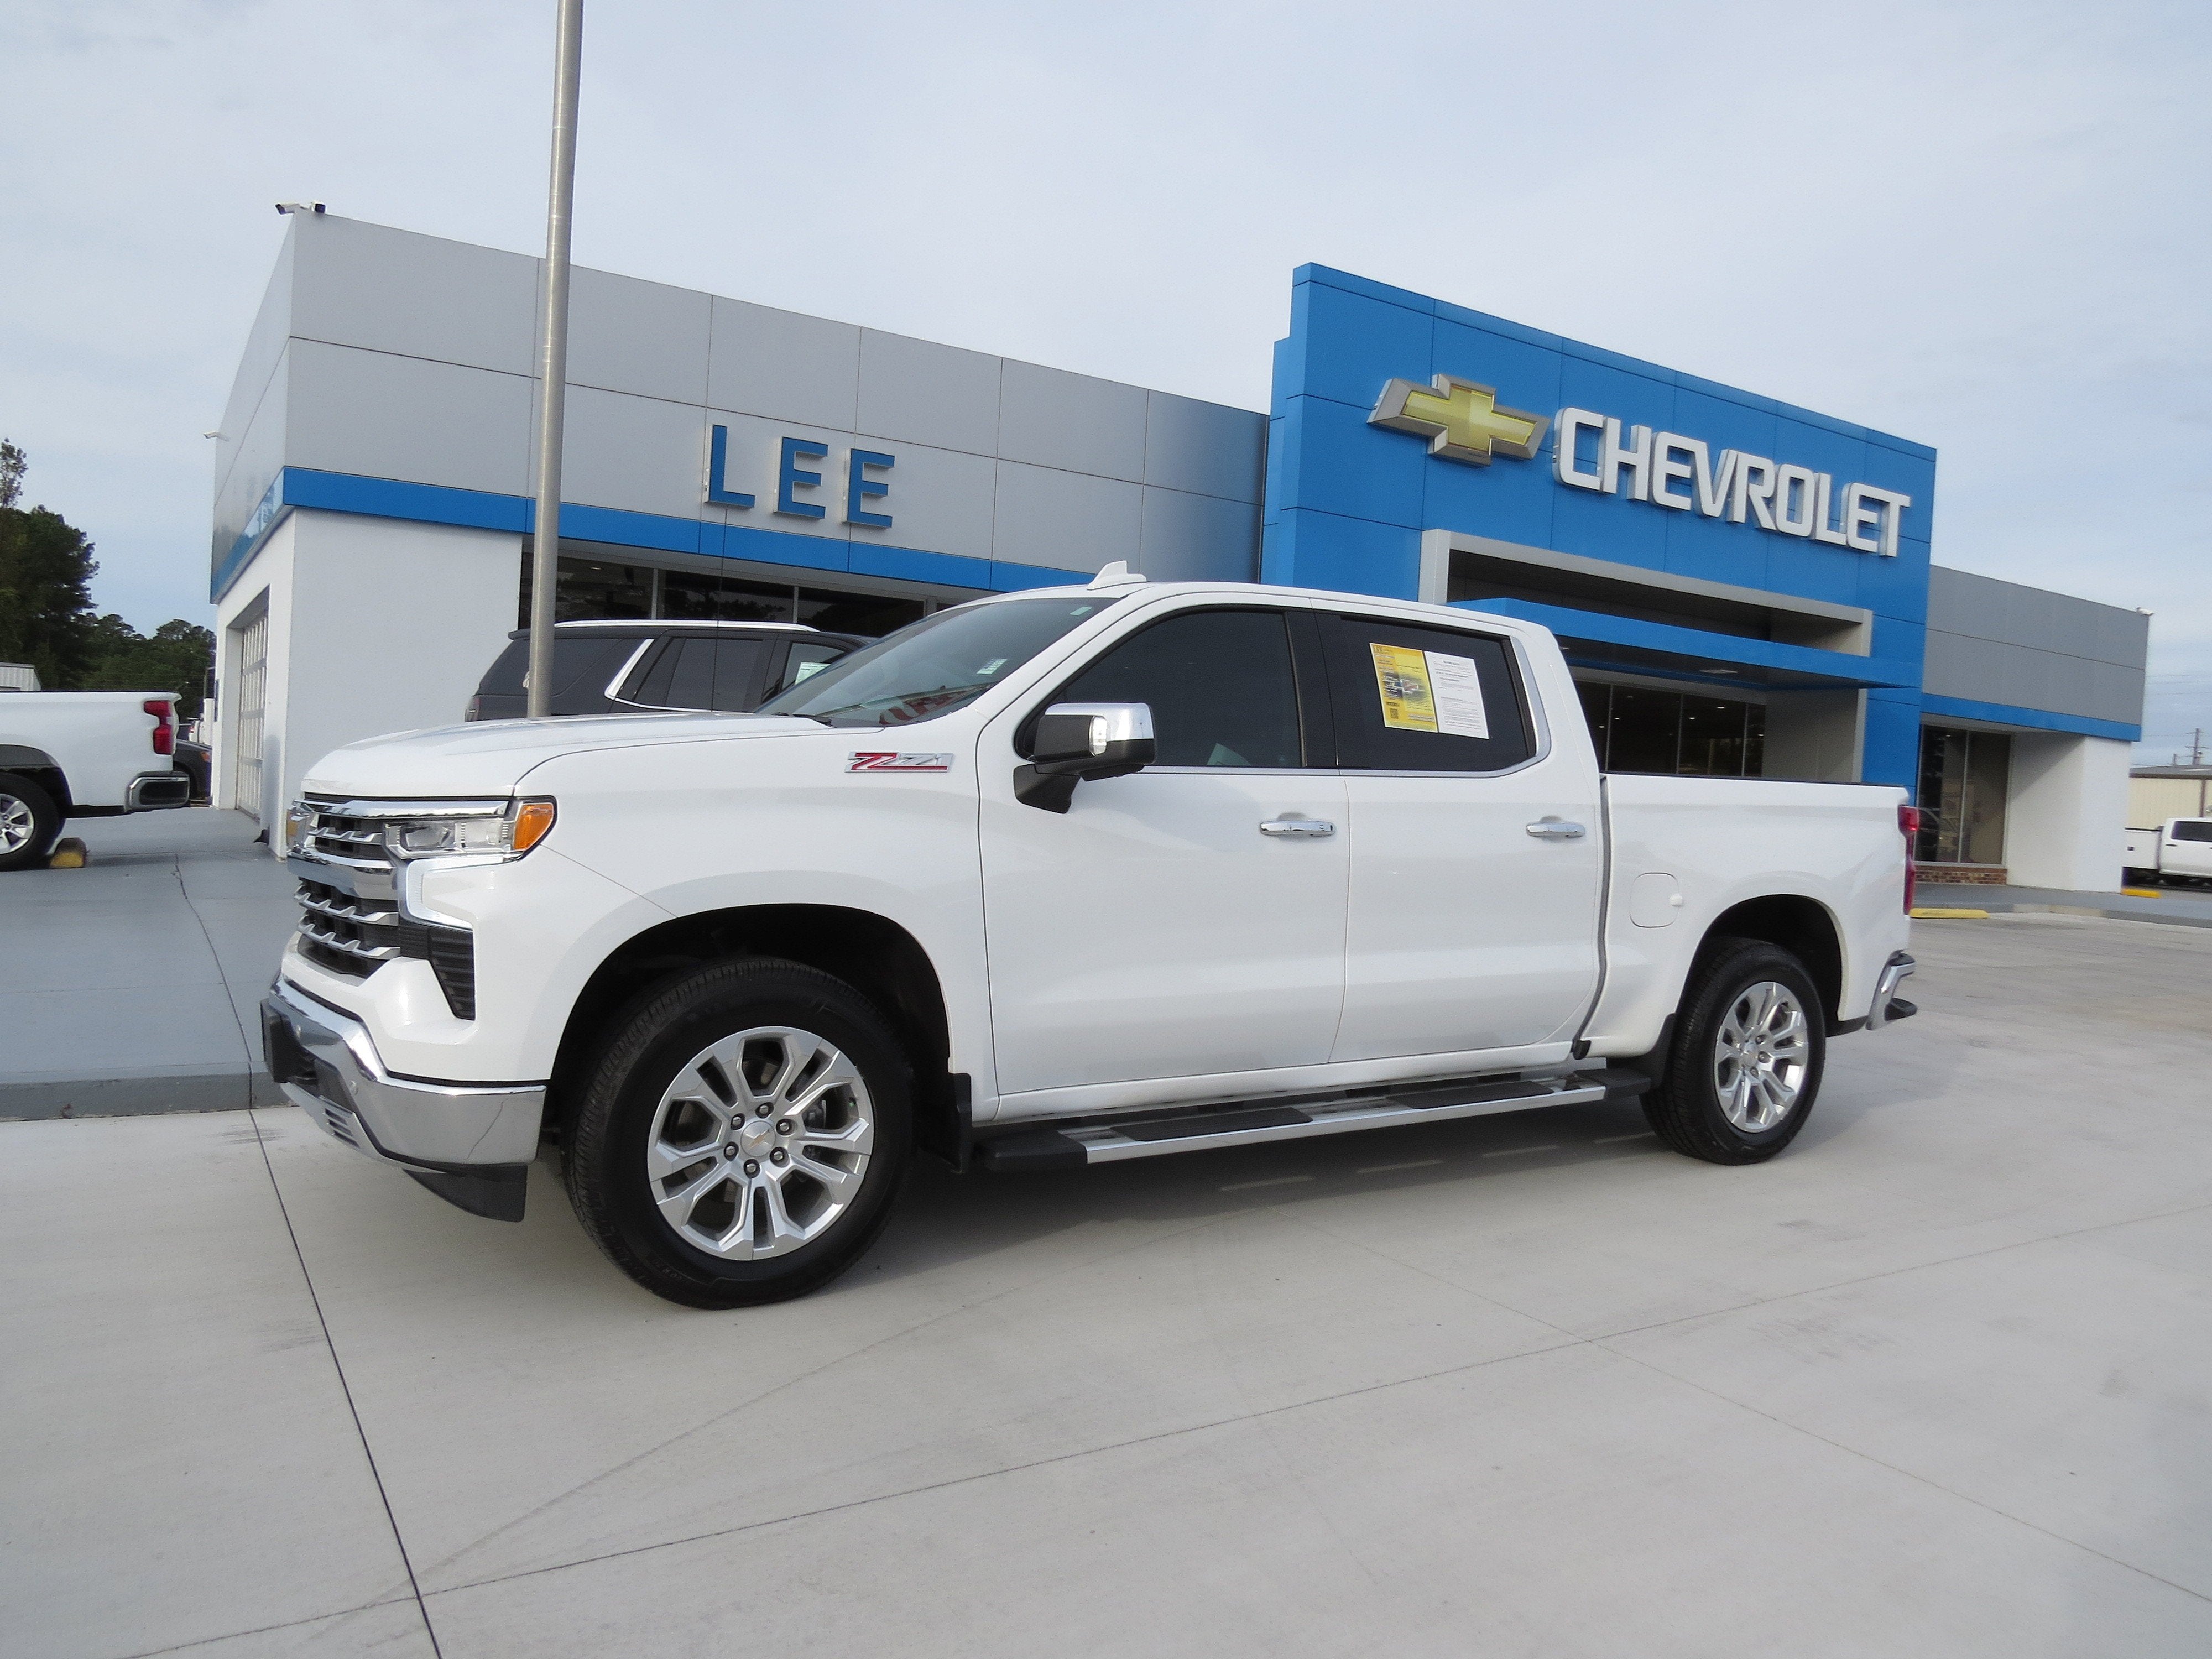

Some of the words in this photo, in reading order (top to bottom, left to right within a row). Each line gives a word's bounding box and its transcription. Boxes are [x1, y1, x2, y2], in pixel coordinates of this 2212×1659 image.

[706, 424, 895, 529] LEE
[1553, 407, 1911, 557] CHEVROLET
[845, 751, 953, 774] Z71
